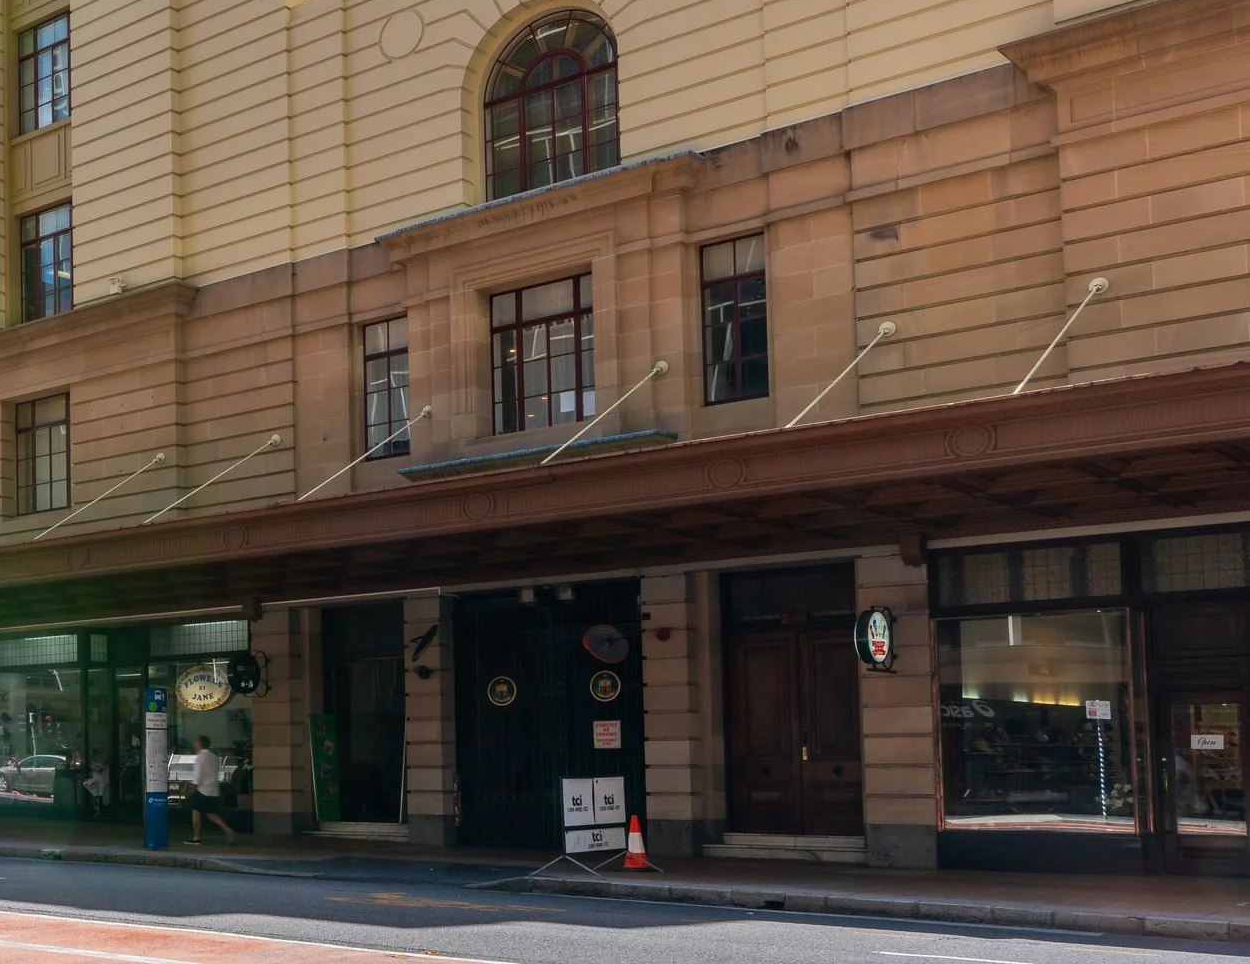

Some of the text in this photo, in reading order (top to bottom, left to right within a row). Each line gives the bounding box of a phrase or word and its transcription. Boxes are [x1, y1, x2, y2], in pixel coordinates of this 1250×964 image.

[183, 674, 224, 689] FLOWERS
[192, 692, 215, 701] JANE
[1197, 736, 1216, 748] Open
[571, 794, 583, 806] tci
[603, 793, 615, 805] tci
[591, 830, 603, 842] tci
